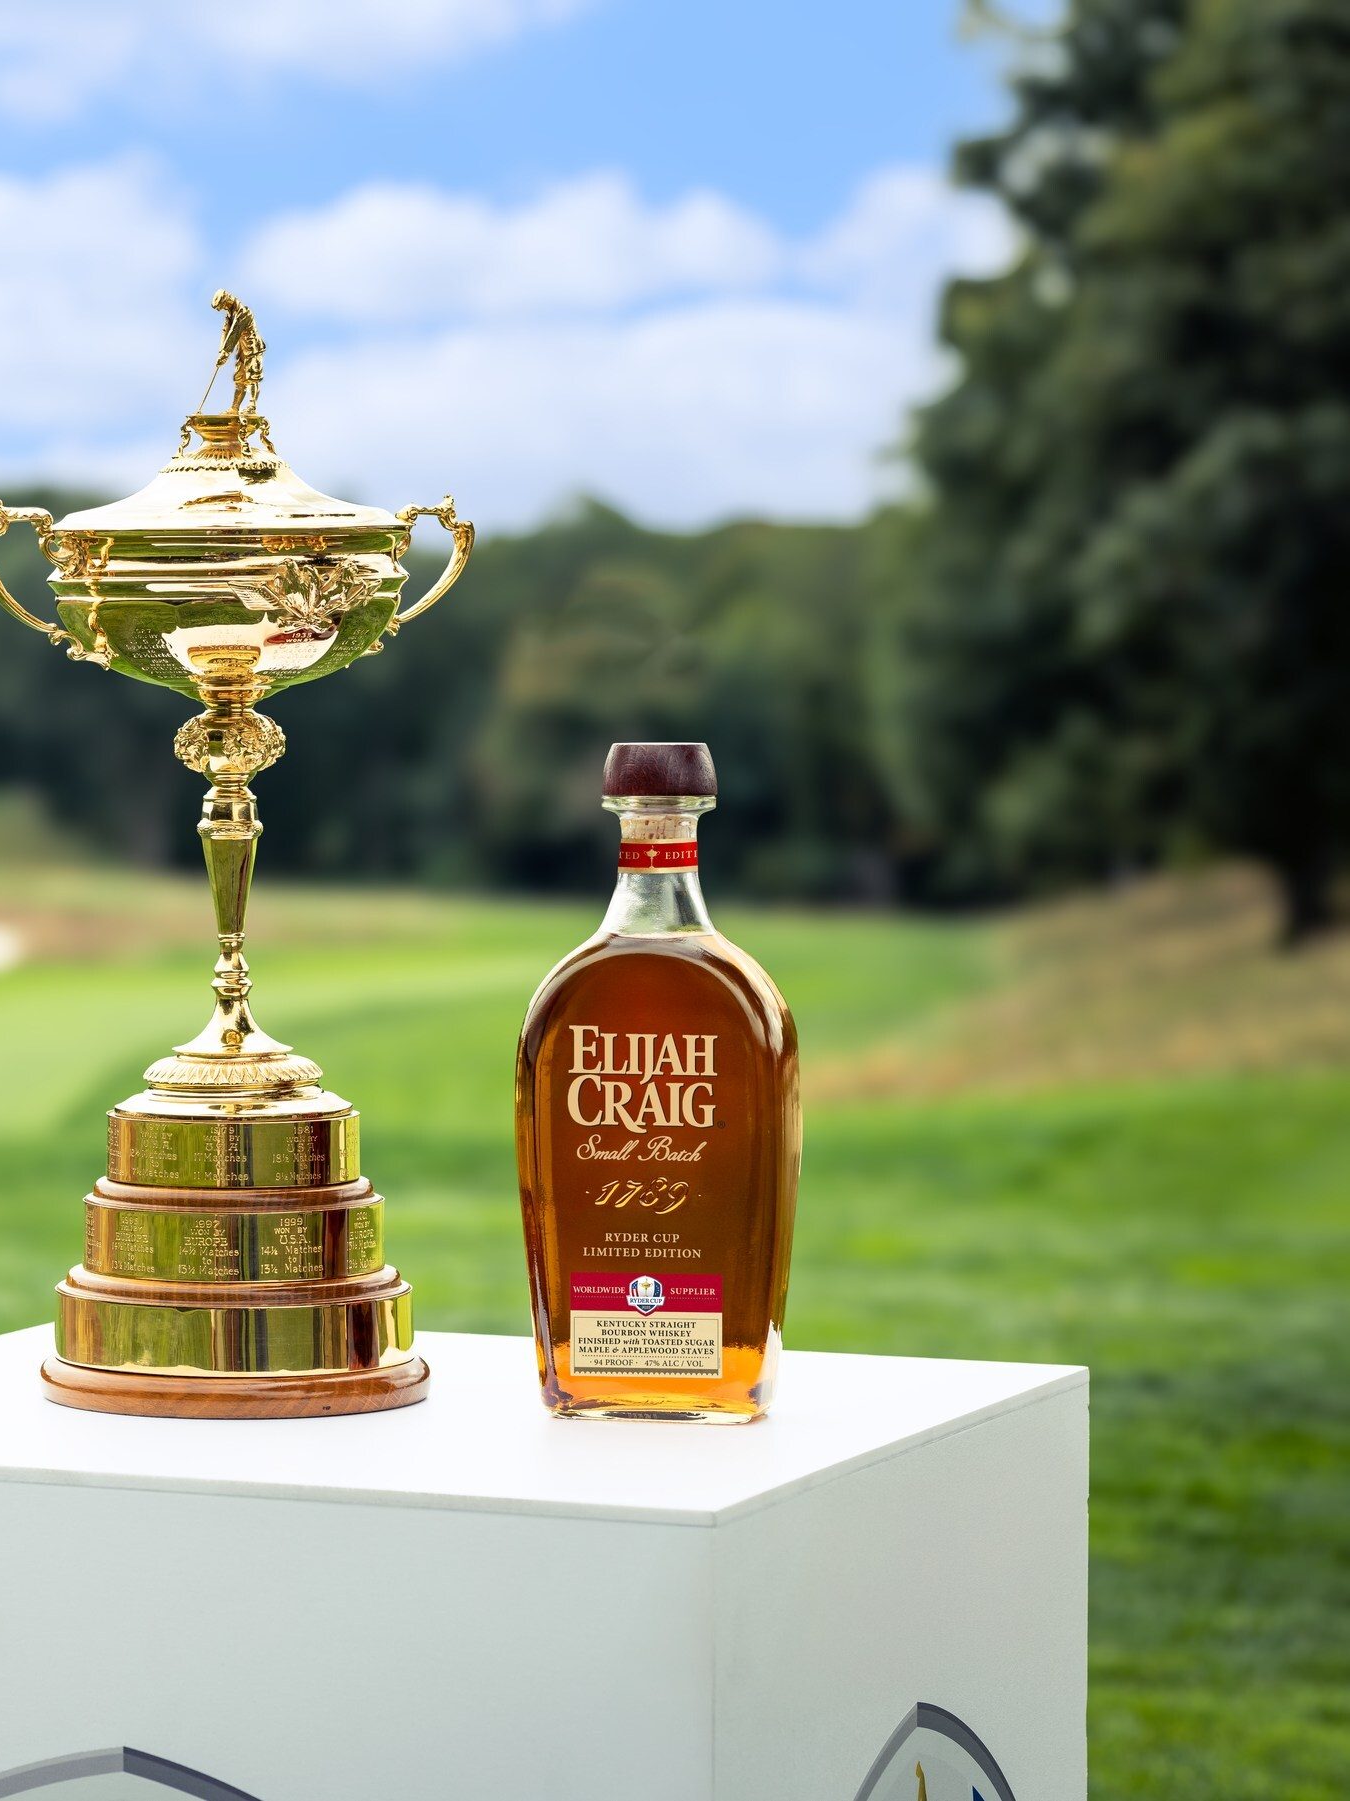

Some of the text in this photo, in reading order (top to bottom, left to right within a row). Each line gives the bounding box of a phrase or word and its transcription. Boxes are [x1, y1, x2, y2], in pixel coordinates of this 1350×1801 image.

[568, 1025, 718, 1085] ELIJAH
[567, 1074, 716, 1134] CRAIG
[293, 1126, 314, 1135] 1981
[577, 1134, 708, 1162] Small Batch
[293, 1153, 326, 1162] Matches
[595, 1177, 689, 1215] 1789
[280, 1218, 303, 1227] 1999
[184, 1237, 228, 1247] EUROPE
[605, 1232, 680, 1243] RYDER CUP
[200, 1247, 239, 1257] Matches
[285, 1245, 323, 1255] Matches
[583, 1247, 702, 1259] LIMITED EDITION
[202, 1257, 212, 1265] to
[288, 1256, 297, 1264] to
[200, 1265, 239, 1276] Matches
[285, 1263, 323, 1273] Matches
[573, 1286, 716, 1296] WORLDWIDE SUPPLIER
[596, 1320, 697, 1329] KENTUCKY STRAIGHT
[601, 1329, 692, 1338] BOURBON WHISKEY
[578, 1337, 621, 1345] FINISHED
[684, 1339, 715, 1347] SUGAR
[578, 1346, 610, 1354] MAPLE
[611, 1346, 620, 1354] &
[621, 1347, 679, 1355] APPLEWOOD
[605, 1359, 634, 1367] PROOF
[644, 1359, 661, 1367] 47%
[662, 1360, 680, 1368] ALC
